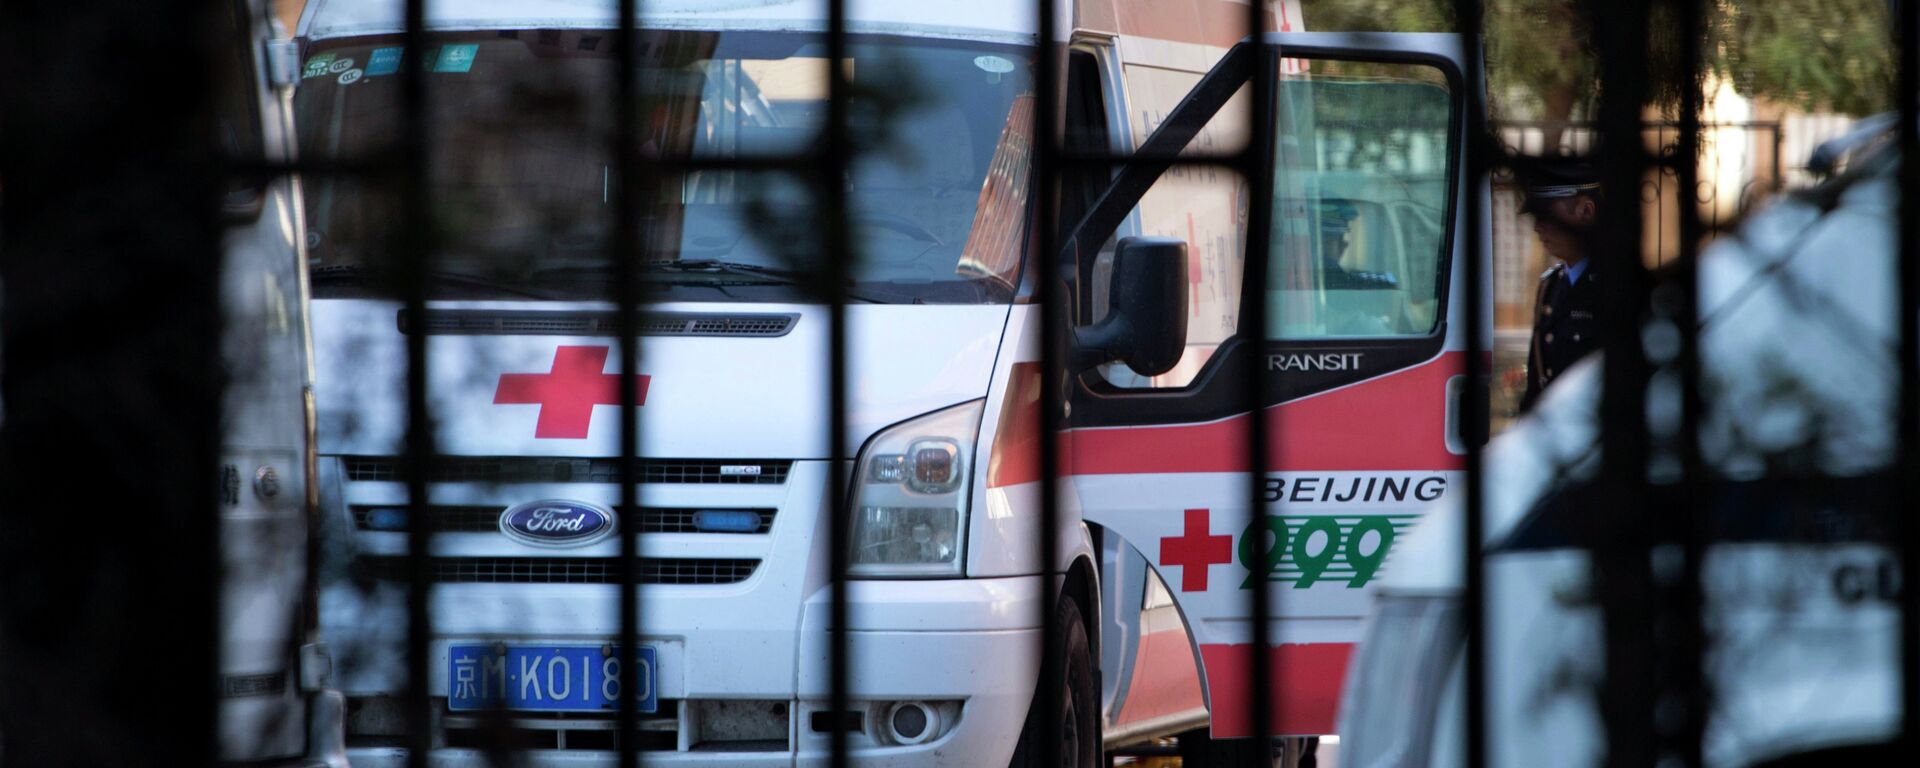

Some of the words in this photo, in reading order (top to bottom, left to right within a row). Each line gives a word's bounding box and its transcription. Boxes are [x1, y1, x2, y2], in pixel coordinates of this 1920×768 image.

[302, 66, 329, 79] 2012
[1265, 353, 1364, 371] RANSIT
[1262, 477, 1445, 502] BEIJING
[526, 507, 585, 532] Ford
[1238, 514, 1396, 590] 999
